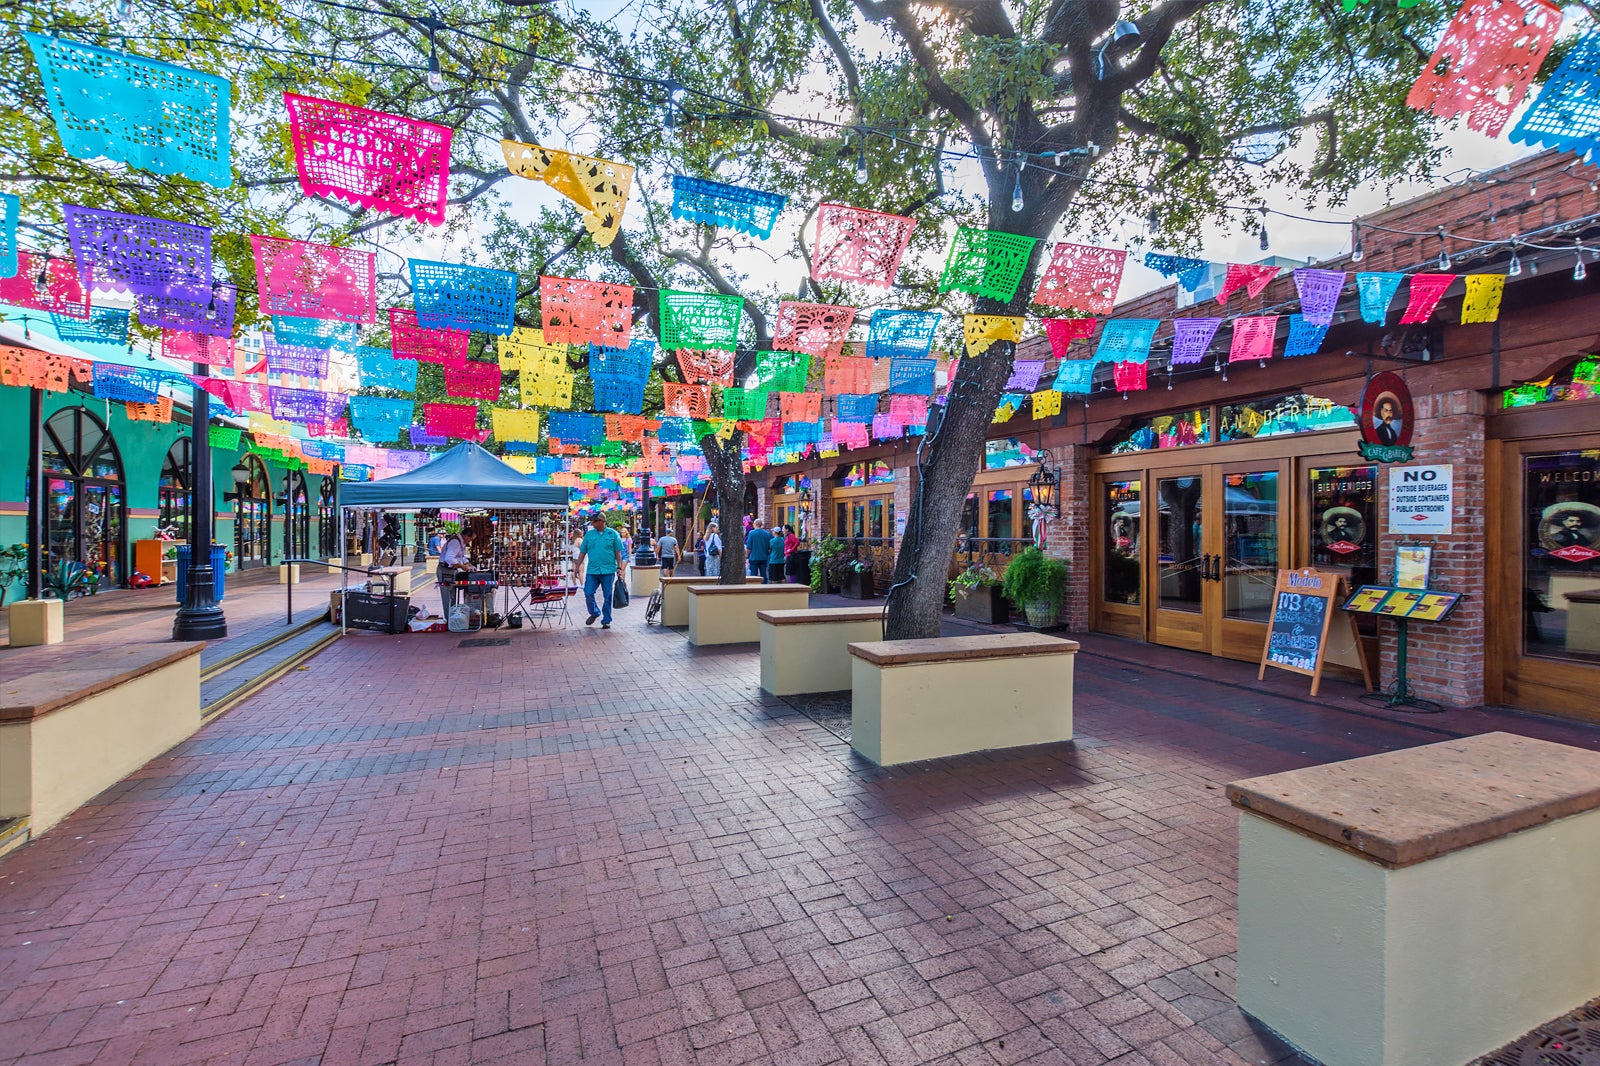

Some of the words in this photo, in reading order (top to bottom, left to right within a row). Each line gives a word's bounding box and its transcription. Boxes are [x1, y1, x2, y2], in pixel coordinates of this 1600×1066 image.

[1180, 421, 1189, 436] Y
[1403, 470, 1438, 483] NO
[1317, 480, 1372, 493] BIENVENIDOS
[1396, 485, 1418, 493] OUTSIDE
[1418, 483, 1448, 492] BEVERAGES
[1396, 495, 1418, 503] OUTSIDE
[1417, 494, 1450, 502] CONTAINERS
[1396, 505, 1414, 513] PUBLIC
[1414, 504, 1445, 513] RESTROOMS
[1288, 572, 1323, 588] Modelo
